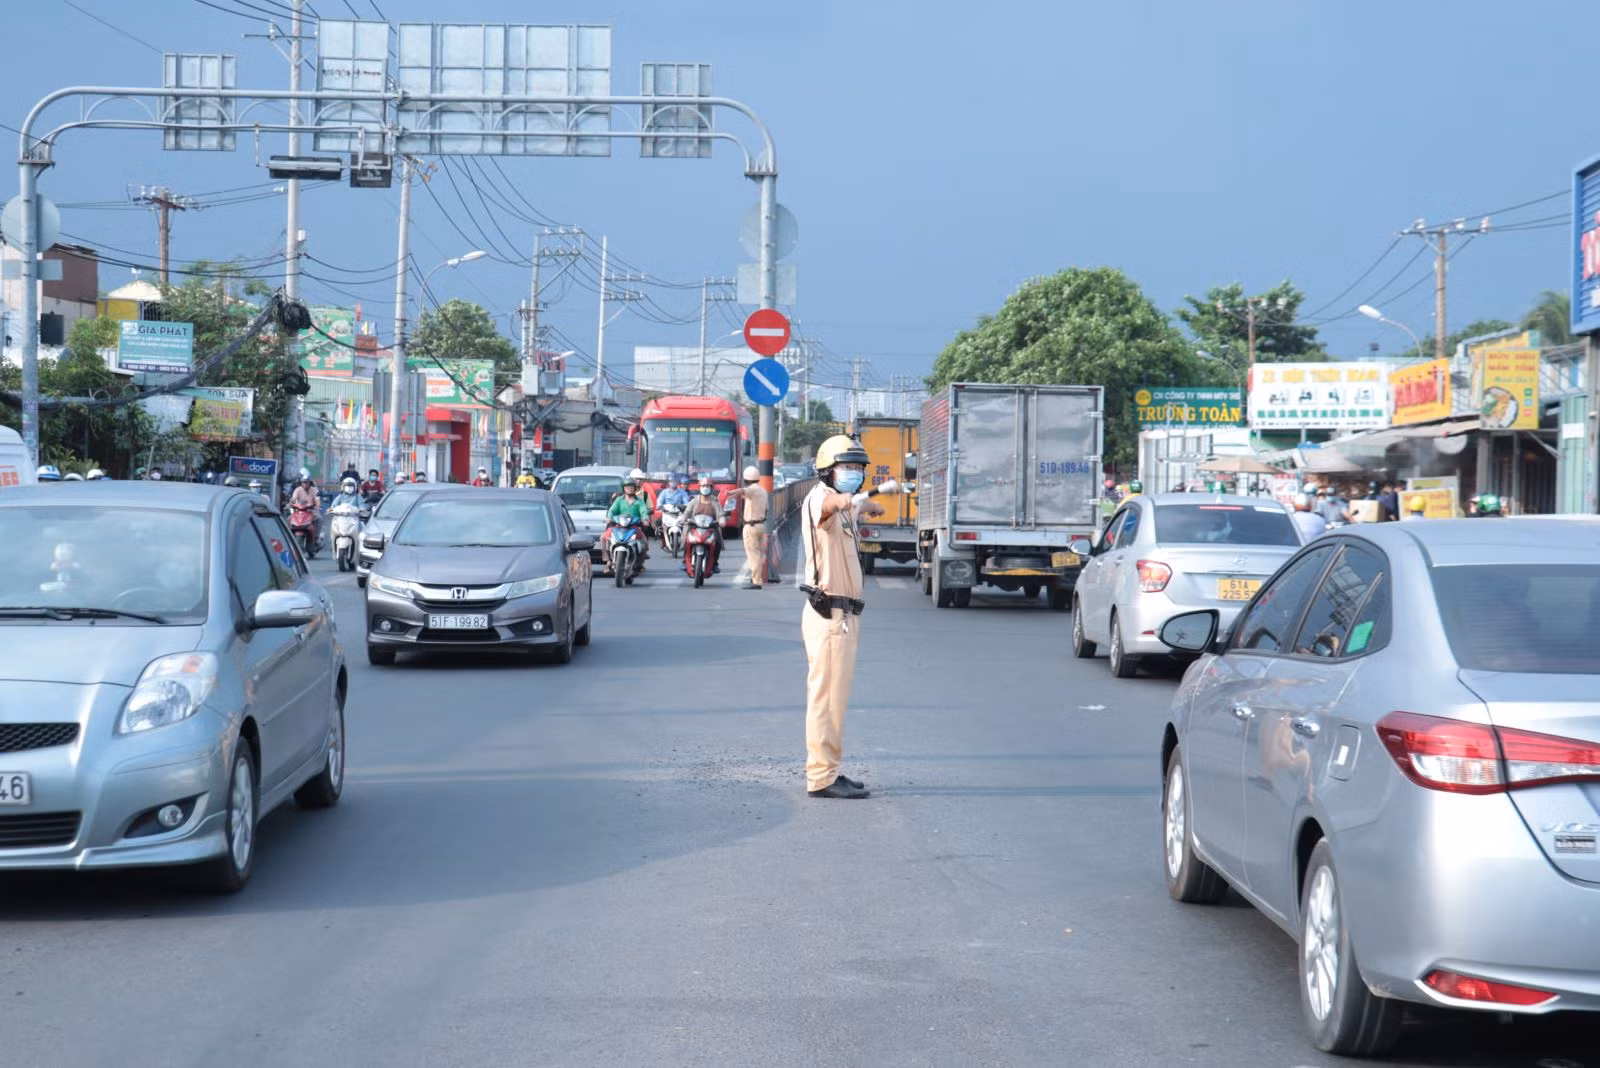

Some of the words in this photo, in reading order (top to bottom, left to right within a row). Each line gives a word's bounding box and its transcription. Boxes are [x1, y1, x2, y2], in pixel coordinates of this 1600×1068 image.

[138, 325, 157, 335] GIA
[1186, 391, 1195, 400] TY
[1231, 580, 1249, 589] 61A
